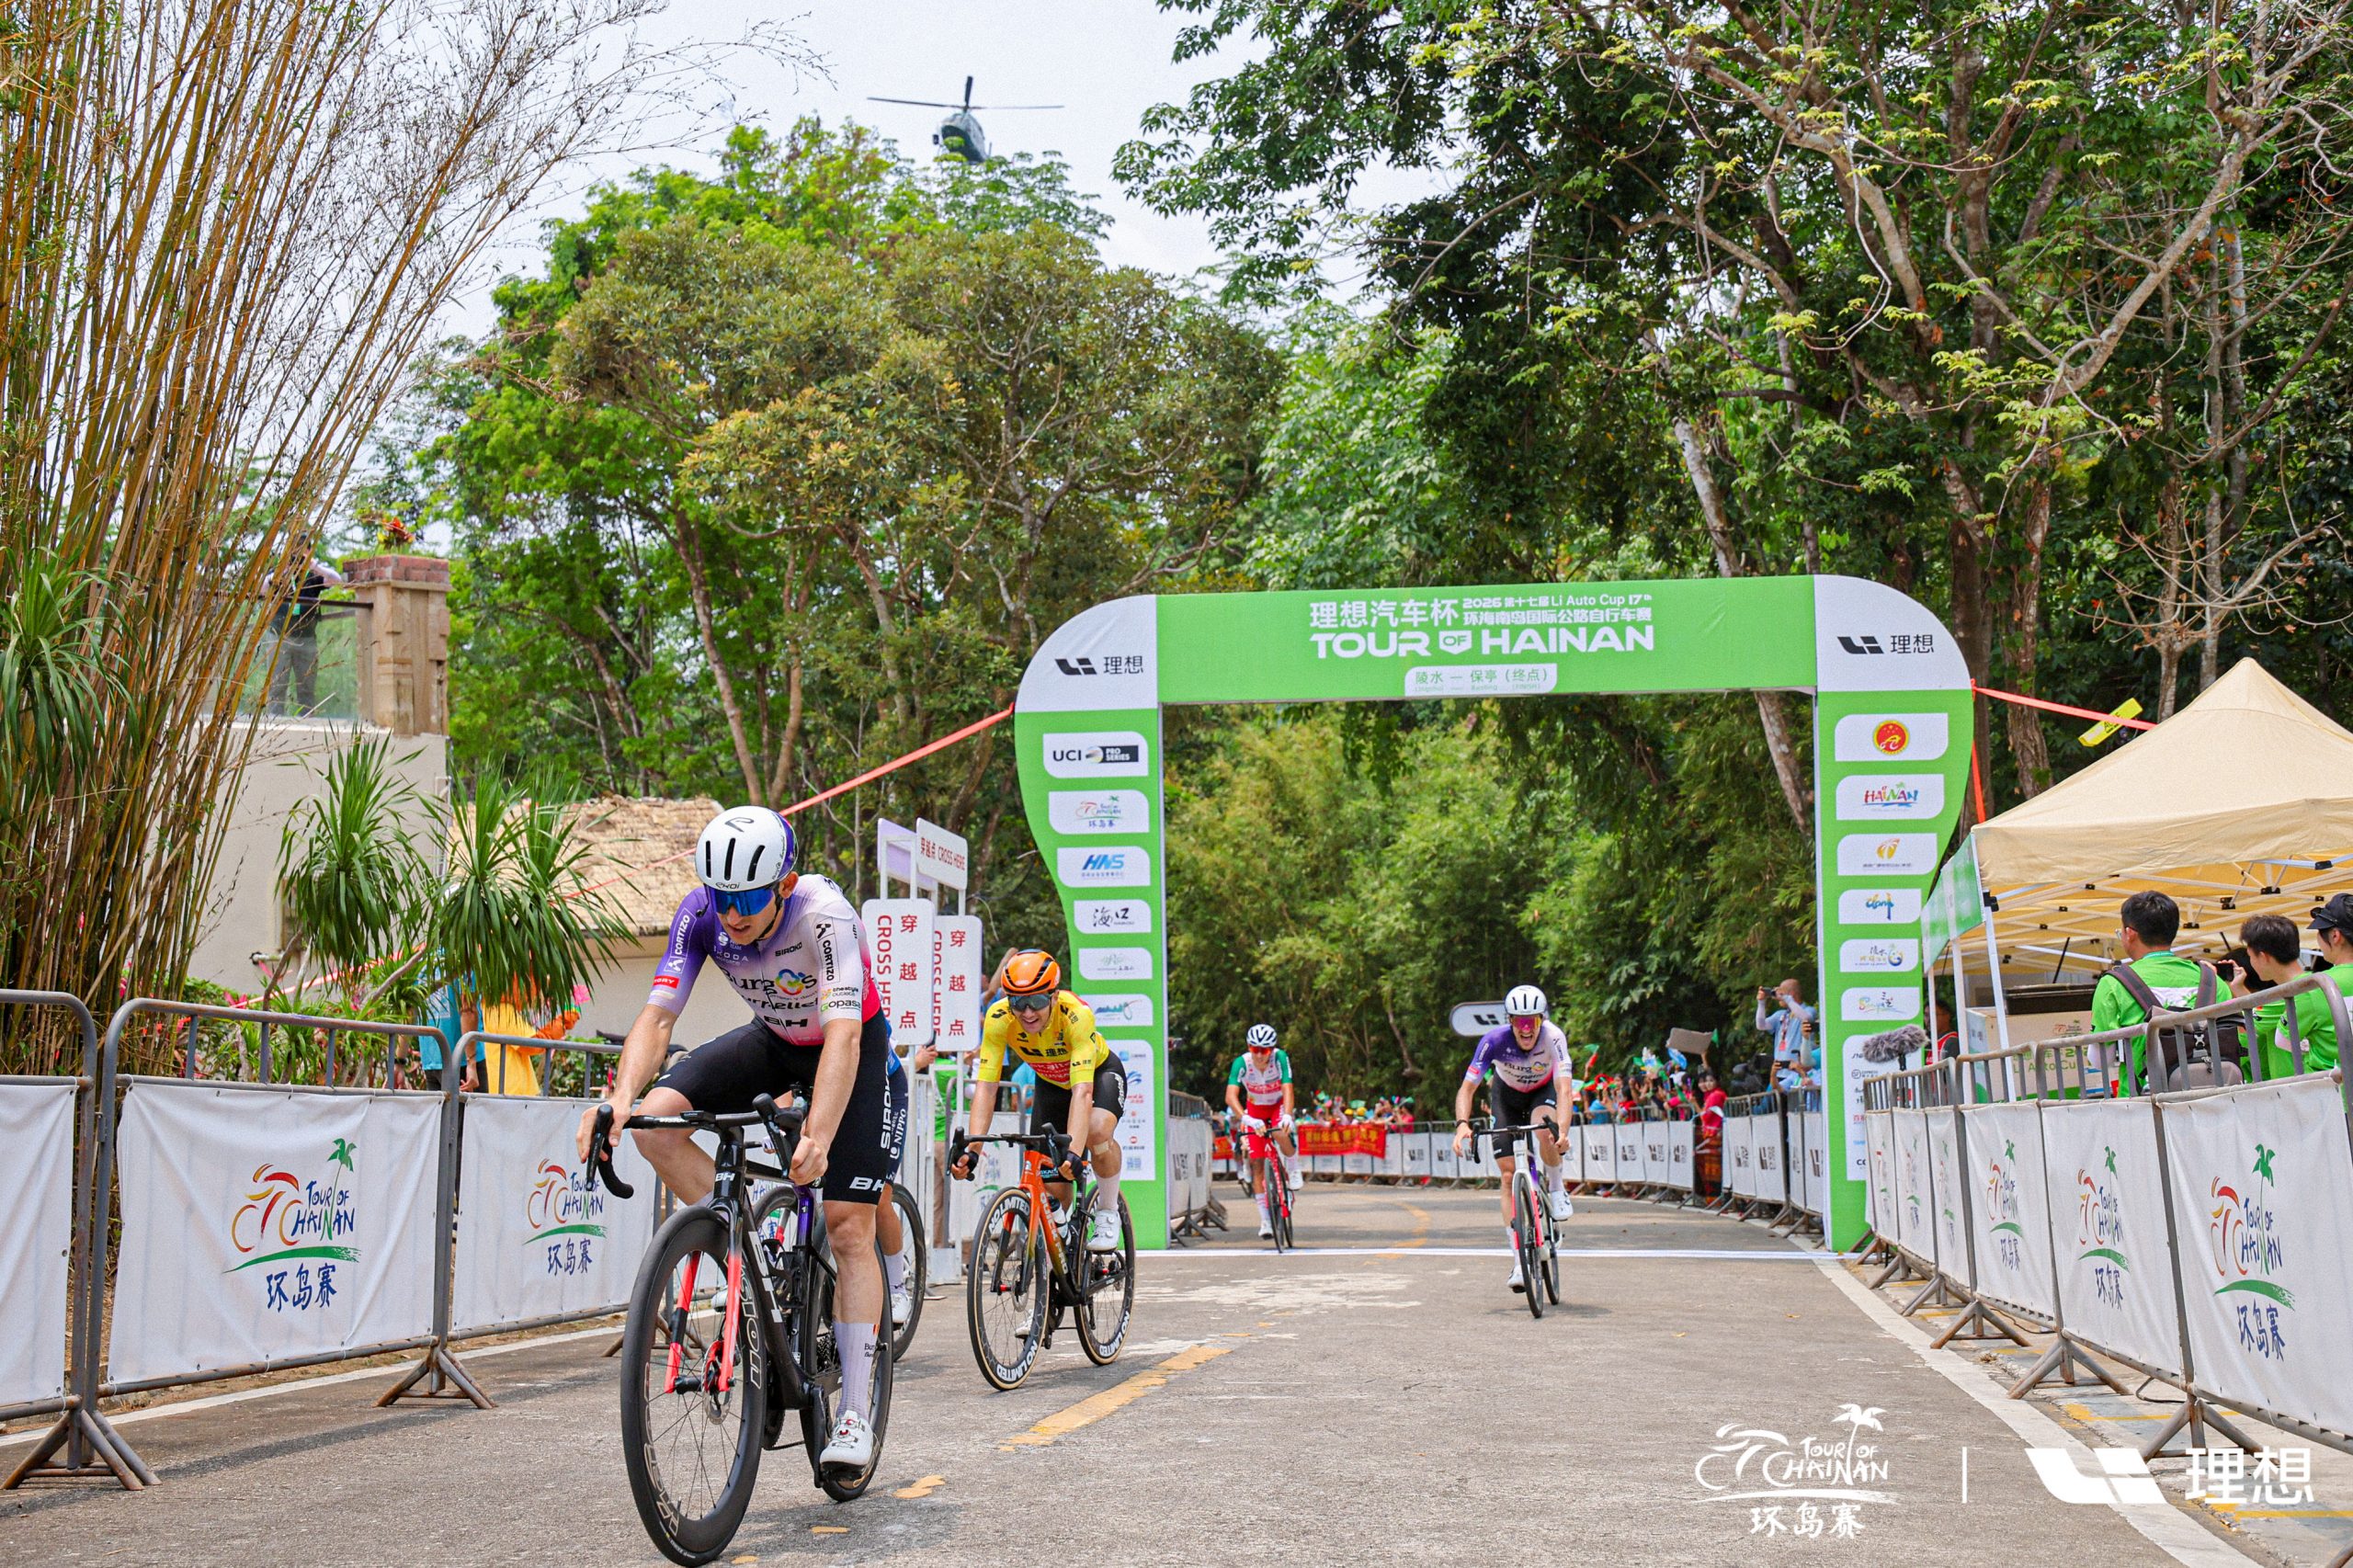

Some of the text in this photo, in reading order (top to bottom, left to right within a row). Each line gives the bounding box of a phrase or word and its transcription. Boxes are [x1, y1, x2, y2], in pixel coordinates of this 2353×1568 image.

[1309, 598, 1460, 629] 理想汽车杯
[1463, 597, 1501, 608] 2026
[1505, 596, 1549, 608] 第十七届
[1552, 595, 1563, 607] Li
[1566, 595, 1597, 607] Auto
[1599, 594, 1625, 607] Cup
[1463, 607, 1653, 625] 环海南岛国际公路自行车赛
[1309, 625, 1654, 660] TOUR OF HAINAN
[1890, 634, 1935, 653] 理想
[1103, 655, 1143, 675] 理想
[1471, 669, 1497, 682] 保亭
[1052, 750, 1082, 762] UCI
[674, 915, 690, 956] CORTIZO
[877, 915, 892, 975] CROSS
[823, 939, 835, 982] CORTIZO
[894, 1108, 906, 1144] NIPPO
[715, 1172, 735, 1182] BH
[336, 1189, 349, 1206] OF
[563, 1194, 604, 1220] HAINAN
[290, 1208, 355, 1241] HAINAN
[548, 1237, 592, 1276] 环岛赛
[266, 1262, 337, 1312] 环岛赛
[2236, 1298, 2285, 1362] 环岛赛
[996, 1339, 1038, 1381] NO LIMITED
